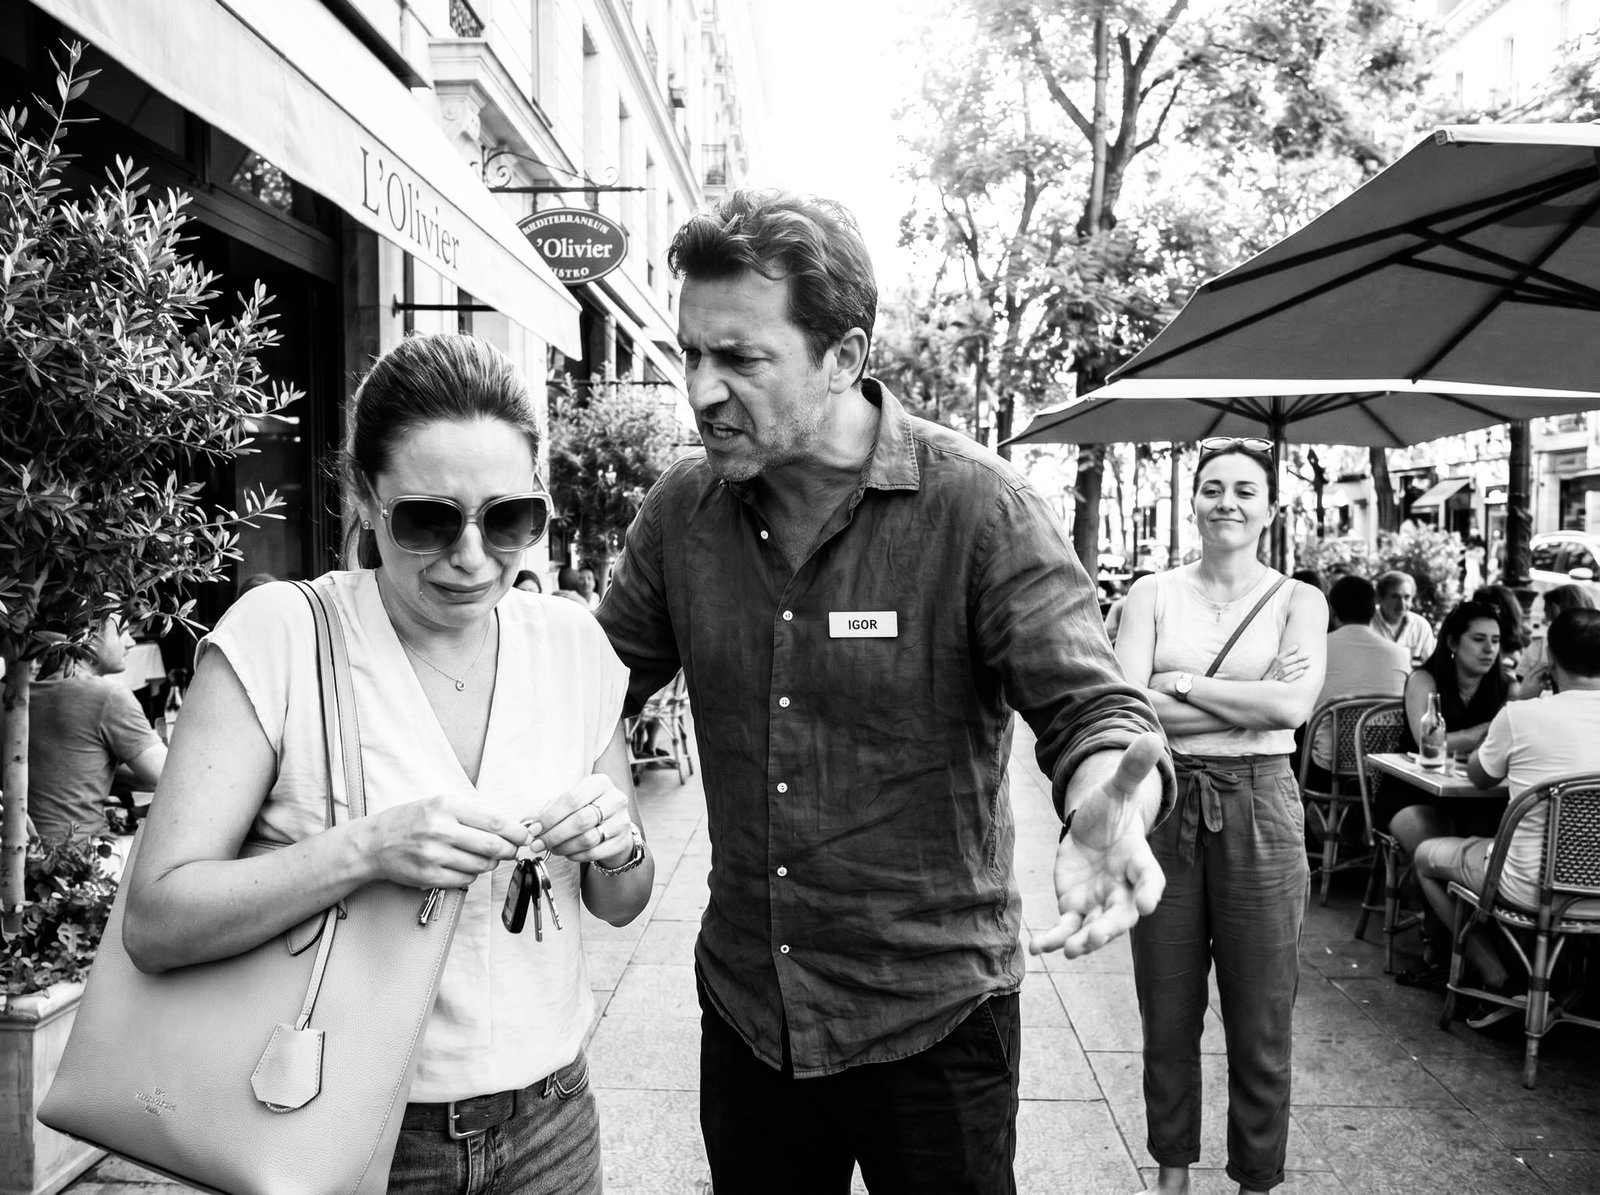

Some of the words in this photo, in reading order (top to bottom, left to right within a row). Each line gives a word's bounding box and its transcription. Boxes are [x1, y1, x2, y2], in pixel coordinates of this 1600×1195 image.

[360, 146, 459, 270] L'Olivier
[536, 237, 613, 258] 'Olivier
[552, 267, 590, 278] ISTRO
[848, 619, 878, 630] IGOR
